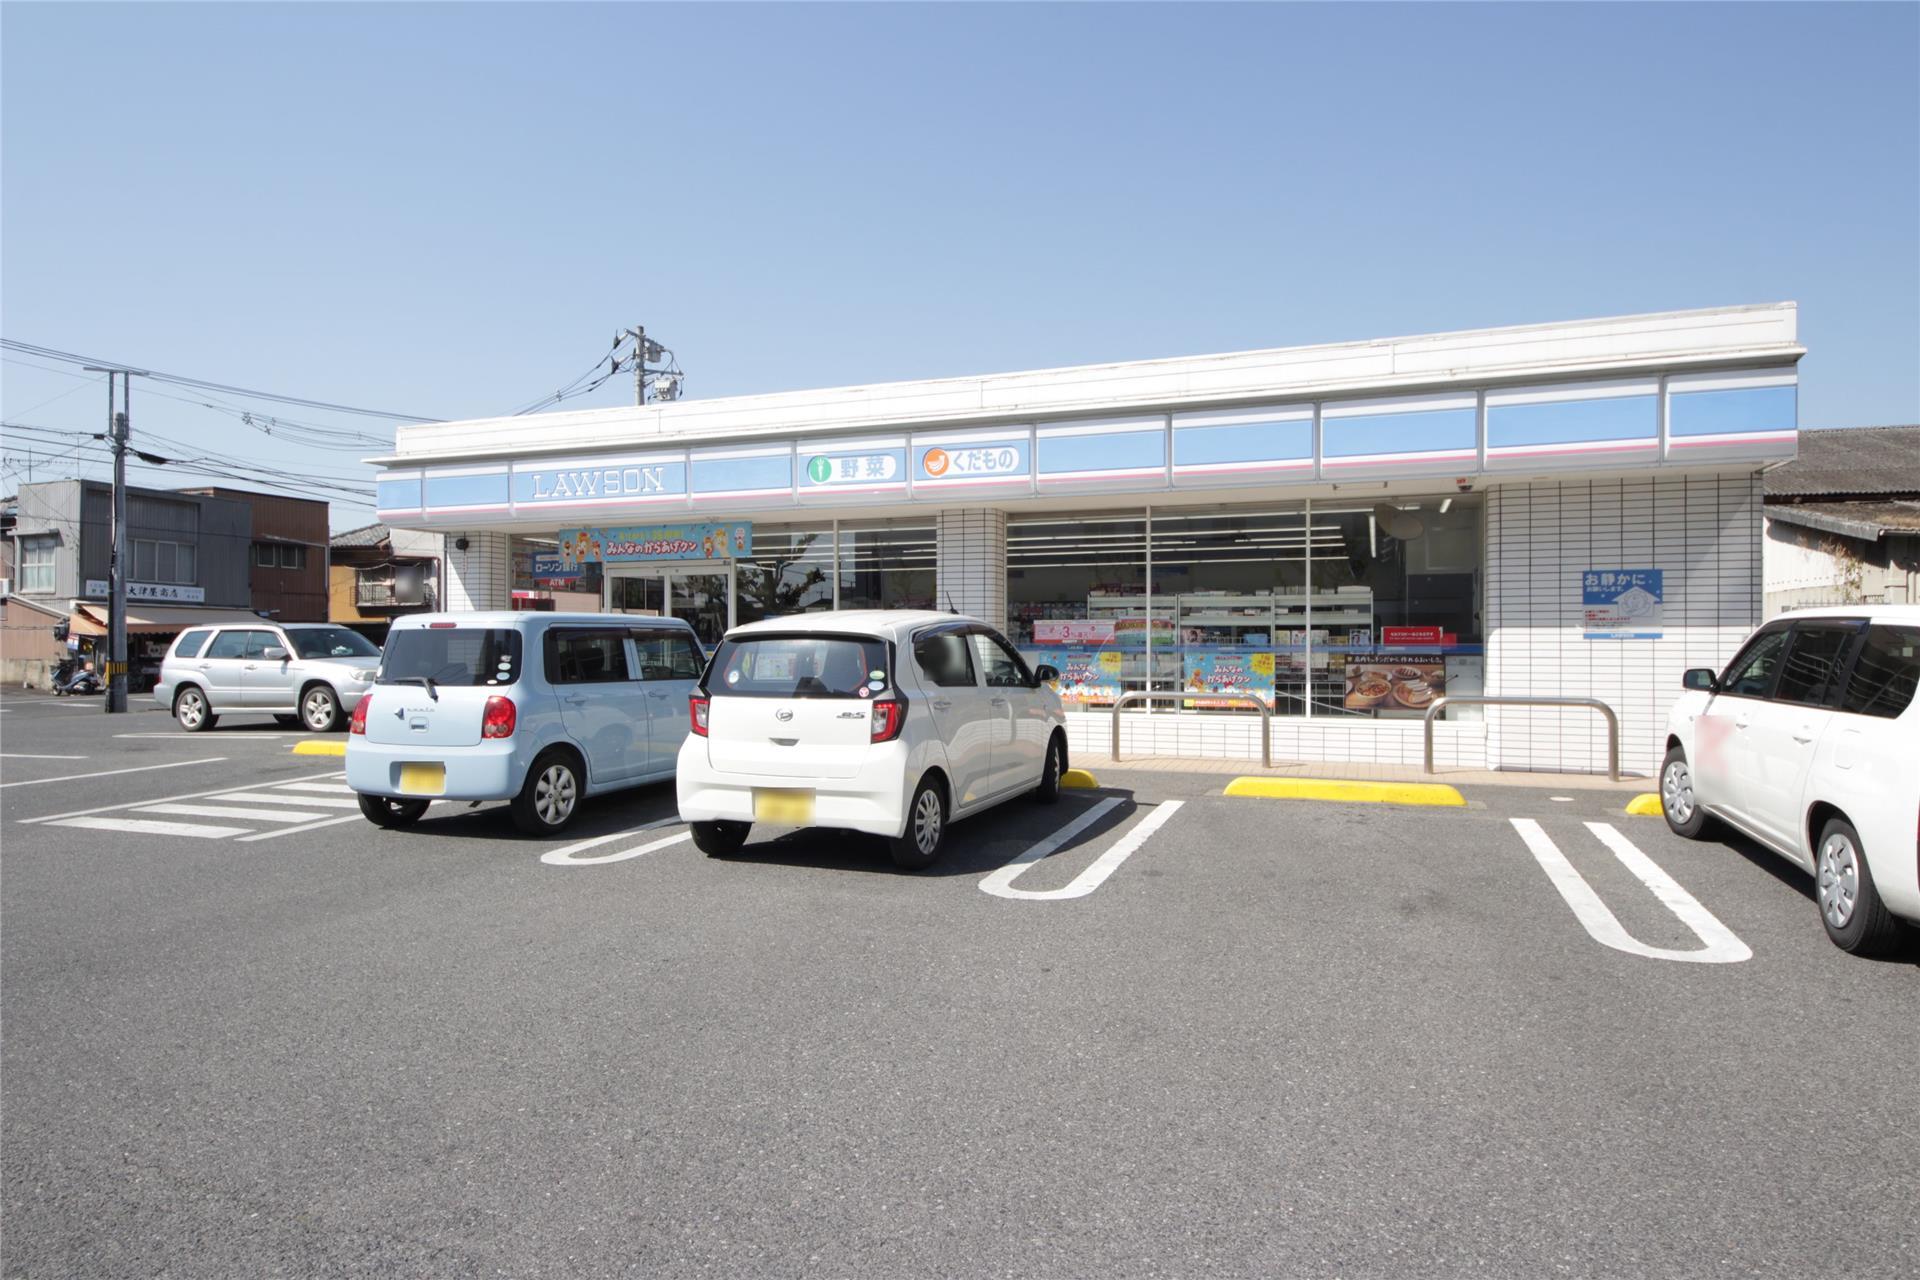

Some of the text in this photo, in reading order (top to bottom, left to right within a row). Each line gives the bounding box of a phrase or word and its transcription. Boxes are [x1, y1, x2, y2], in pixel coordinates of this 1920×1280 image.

[840, 455, 886, 479] 野菜
[952, 449, 1014, 472] くだもの
[532, 467, 665, 498] LAWSON
[606, 539, 698, 556] みんなのからあげクン
[549, 578, 565, 586] ATM
[1584, 573, 1646, 586] お静かに
[1214, 664, 1243, 673] みんなの
[1207, 674, 1251, 684] からあげクン
